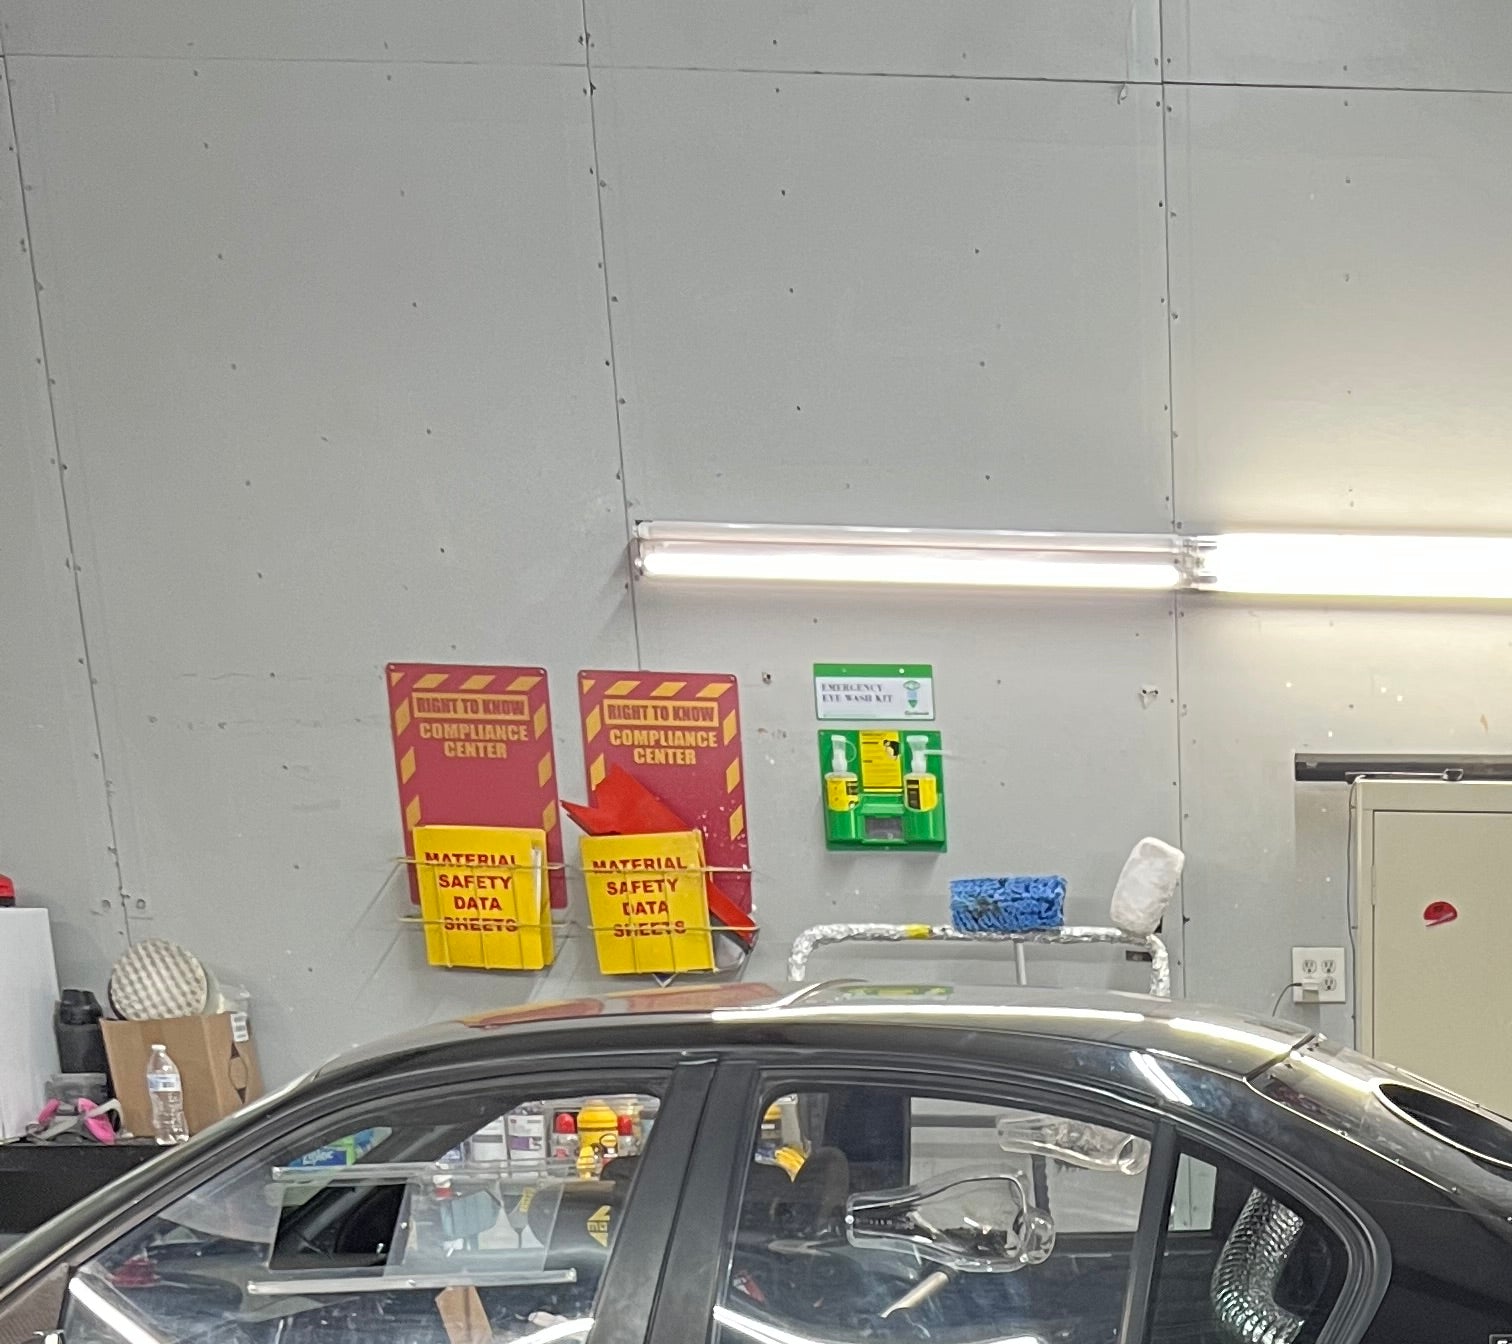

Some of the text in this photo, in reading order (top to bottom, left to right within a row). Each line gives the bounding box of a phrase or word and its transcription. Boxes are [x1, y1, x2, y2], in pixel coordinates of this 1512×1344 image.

[821, 683, 883, 692] EMERGENCY
[416, 697, 525, 716] RIGHT TO KNOW
[844, 694, 873, 703] WASH
[875, 694, 893, 703] KIT
[607, 704, 715, 722] RIGHT TO KNOW
[419, 722, 529, 741] COMPLIANCE
[609, 728, 718, 748] COMPLIANCE
[443, 741, 507, 759] CENTER
[633, 747, 697, 765] CENTER
[592, 856, 688, 873] MATERIAL
[438, 874, 512, 890] SAFETY
[606, 878, 679, 896] SAFETY
[453, 895, 503, 911] DATA
[622, 900, 669, 916] DATA
[444, 916, 519, 932] SHEETS
[613, 920, 687, 938] SHEETS
